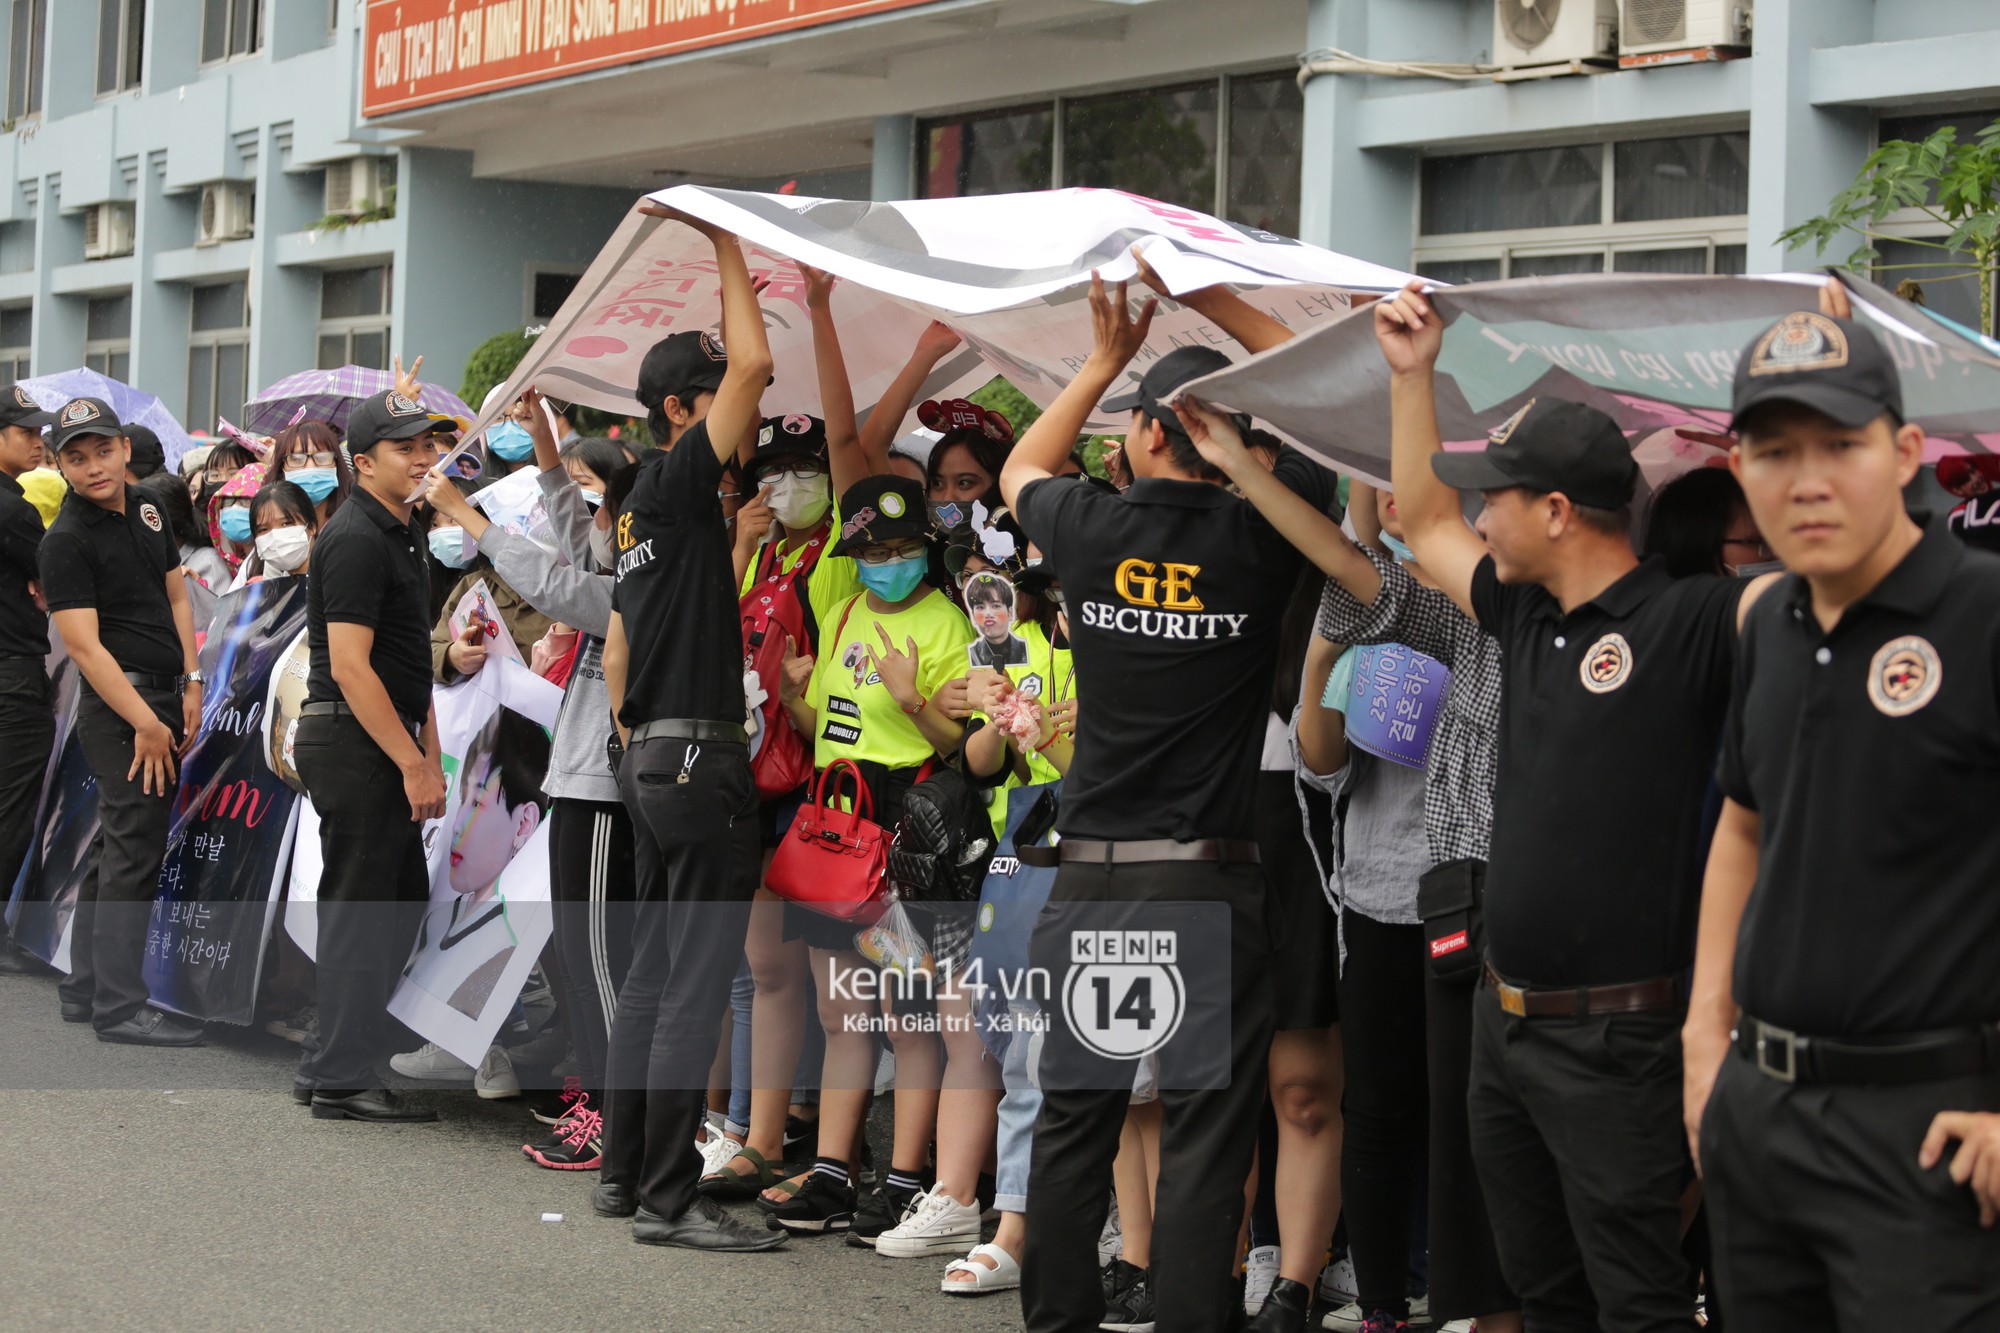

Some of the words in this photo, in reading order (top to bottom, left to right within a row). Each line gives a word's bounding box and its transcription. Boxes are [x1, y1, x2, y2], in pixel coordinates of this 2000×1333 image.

[375, 6, 402, 89] CHỦ
[404, 20, 434, 94] TỊCH
[484, 0, 523, 64] MINH
[1115, 557, 1205, 611] GE
[1082, 601, 1248, 639] SECURITY
[828, 724, 853, 739] DOUBLE
[194, 832, 226, 862] 만날
[169, 901, 211, 929] 보내는
[176, 935, 231, 971] 시간이다
[1432, 935, 1465, 953] Supreme
